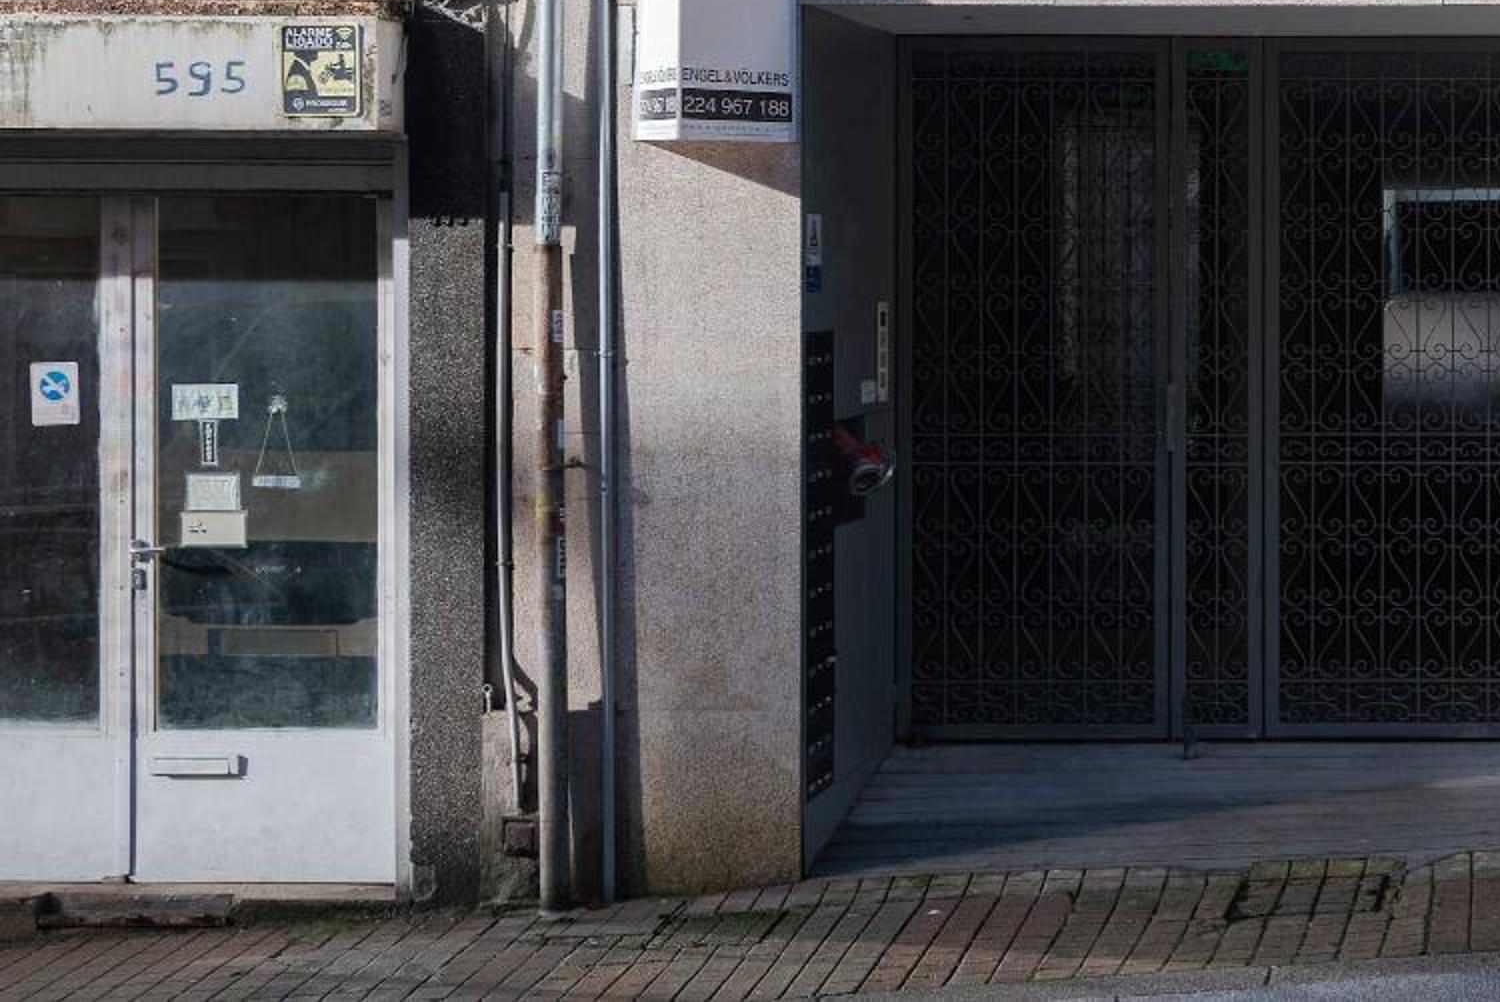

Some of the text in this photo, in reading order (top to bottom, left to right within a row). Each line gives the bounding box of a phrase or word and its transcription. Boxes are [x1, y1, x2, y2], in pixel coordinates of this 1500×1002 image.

[154, 60, 246, 97] 595
[684, 95, 717, 114] 224
[721, 97, 753, 115] 967
[759, 99, 789, 117] 188
